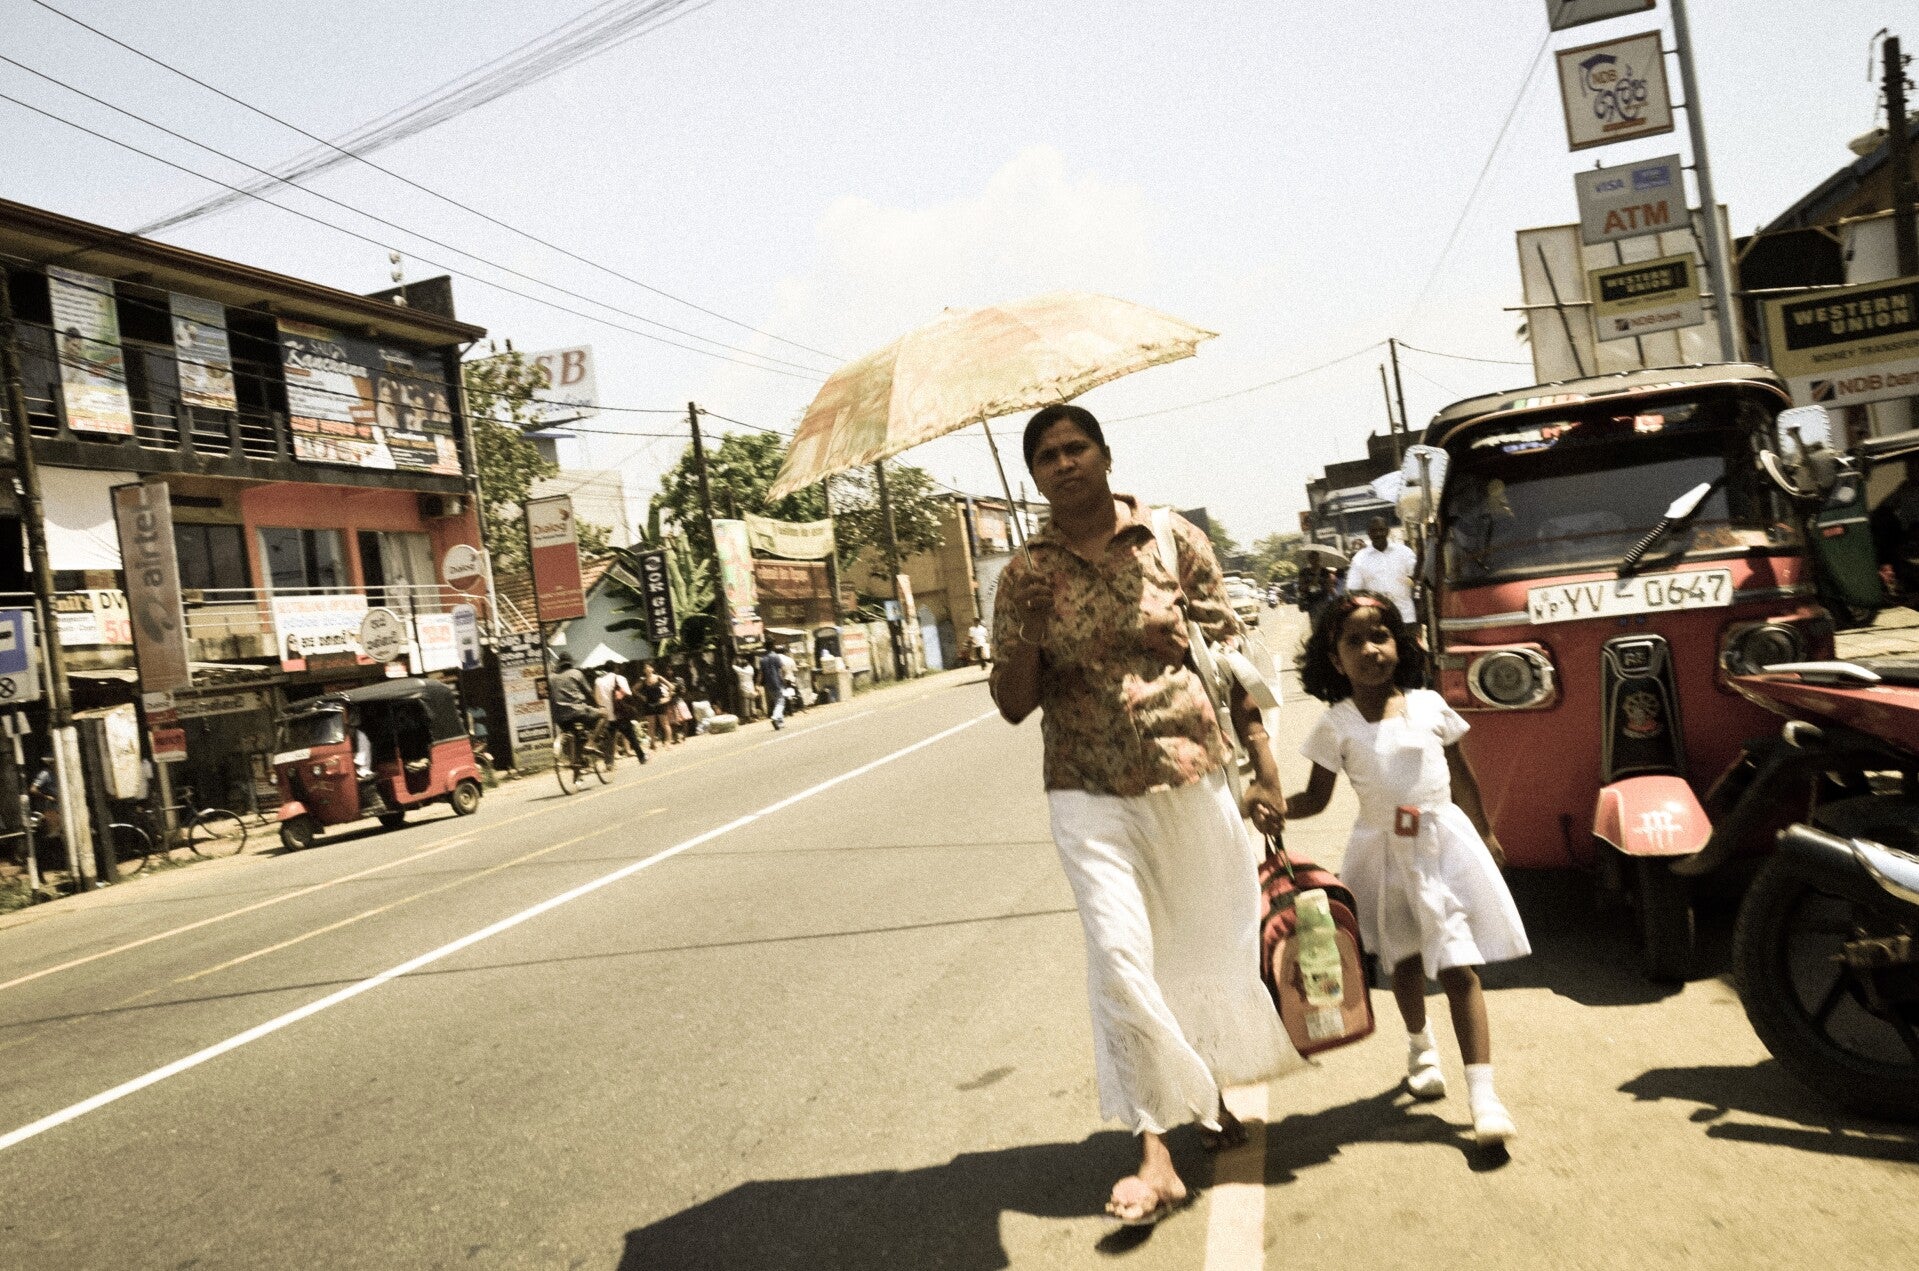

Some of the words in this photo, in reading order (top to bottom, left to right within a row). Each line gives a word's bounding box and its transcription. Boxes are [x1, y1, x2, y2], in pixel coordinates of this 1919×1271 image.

[1602, 201, 1669, 235] ATM
[1793, 294, 1908, 326] WESTERN
[1830, 309, 1909, 335] UNION
[1838, 374, 1883, 396] NDB
[130, 503, 164, 588] airtel
